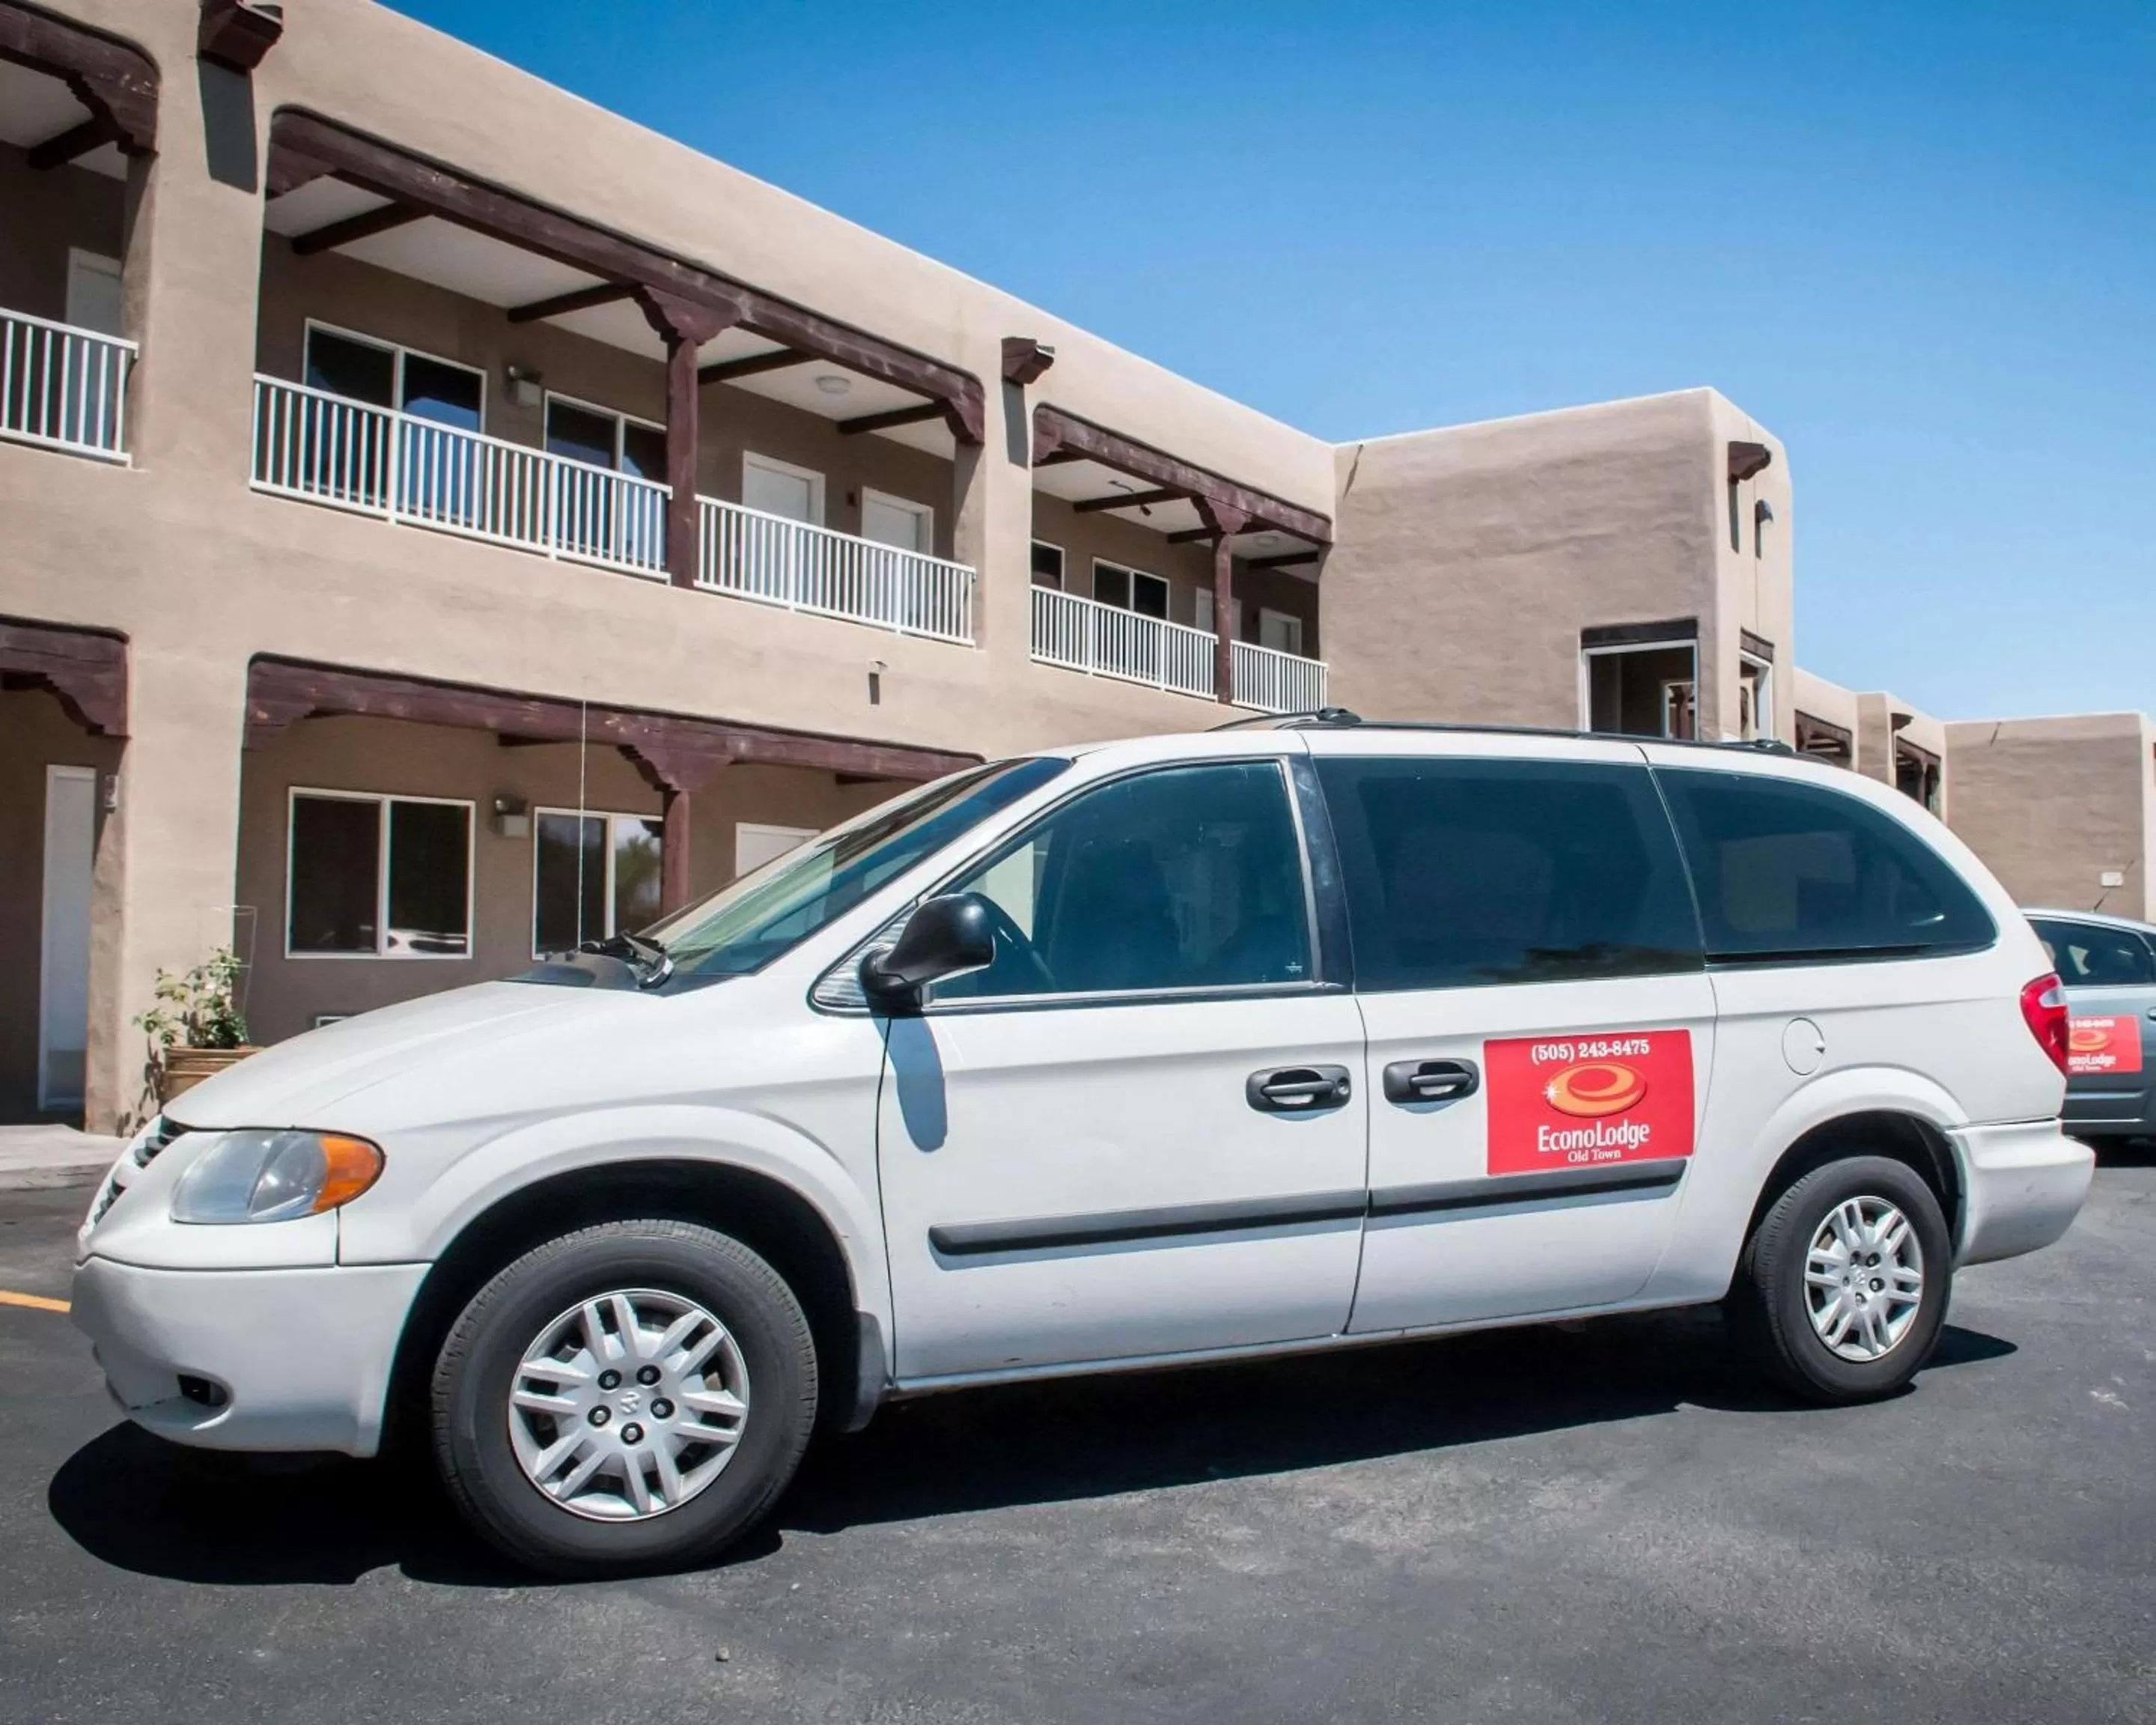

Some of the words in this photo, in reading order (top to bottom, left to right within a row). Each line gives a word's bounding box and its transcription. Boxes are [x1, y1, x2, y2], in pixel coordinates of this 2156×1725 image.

[1531, 1044, 1574, 1065] (505)
[1579, 1039, 1650, 1058] 243-8475
[1538, 1120, 1650, 1151] EconoLodge
[1568, 1150, 1589, 1163] Old
[1592, 1148, 1621, 1160] Town
